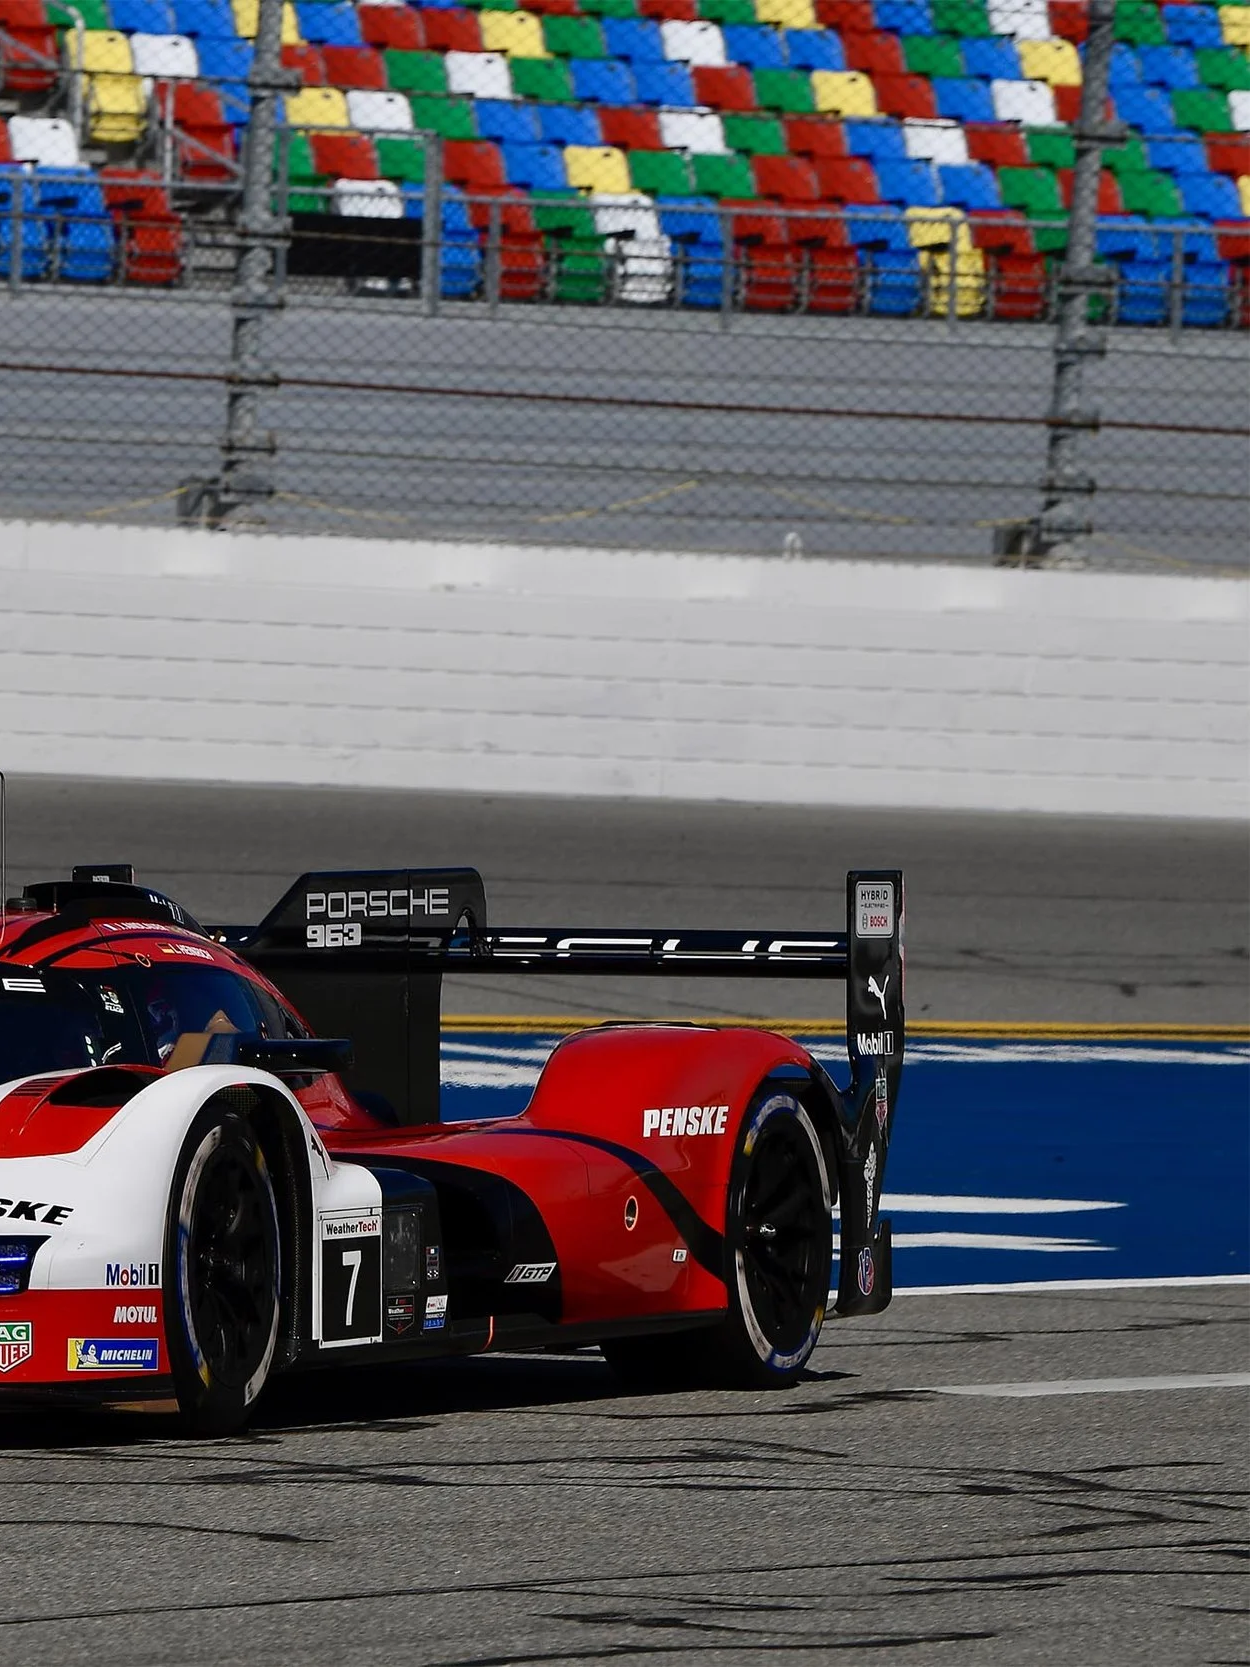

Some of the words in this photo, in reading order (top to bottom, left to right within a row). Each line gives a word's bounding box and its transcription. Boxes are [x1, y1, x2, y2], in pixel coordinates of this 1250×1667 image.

[306, 888, 450, 920] PORSCHE
[860, 889, 889, 901] HYBRID
[869, 915, 888, 928] BOSCH
[306, 922, 362, 948] 963
[857, 1032, 883, 1056] Mobil
[642, 1105, 730, 1138] PENSKE
[325, 1219, 378, 1236] WeatherTech
[106, 1263, 146, 1286] Mobil
[149, 1263, 159, 1286] 1
[520, 1266, 553, 1280] GTP
[342, 1250, 362, 1326] 7
[113, 1305, 158, 1324] MOTUL
[100, 1348, 153, 1362] MICHELIN
